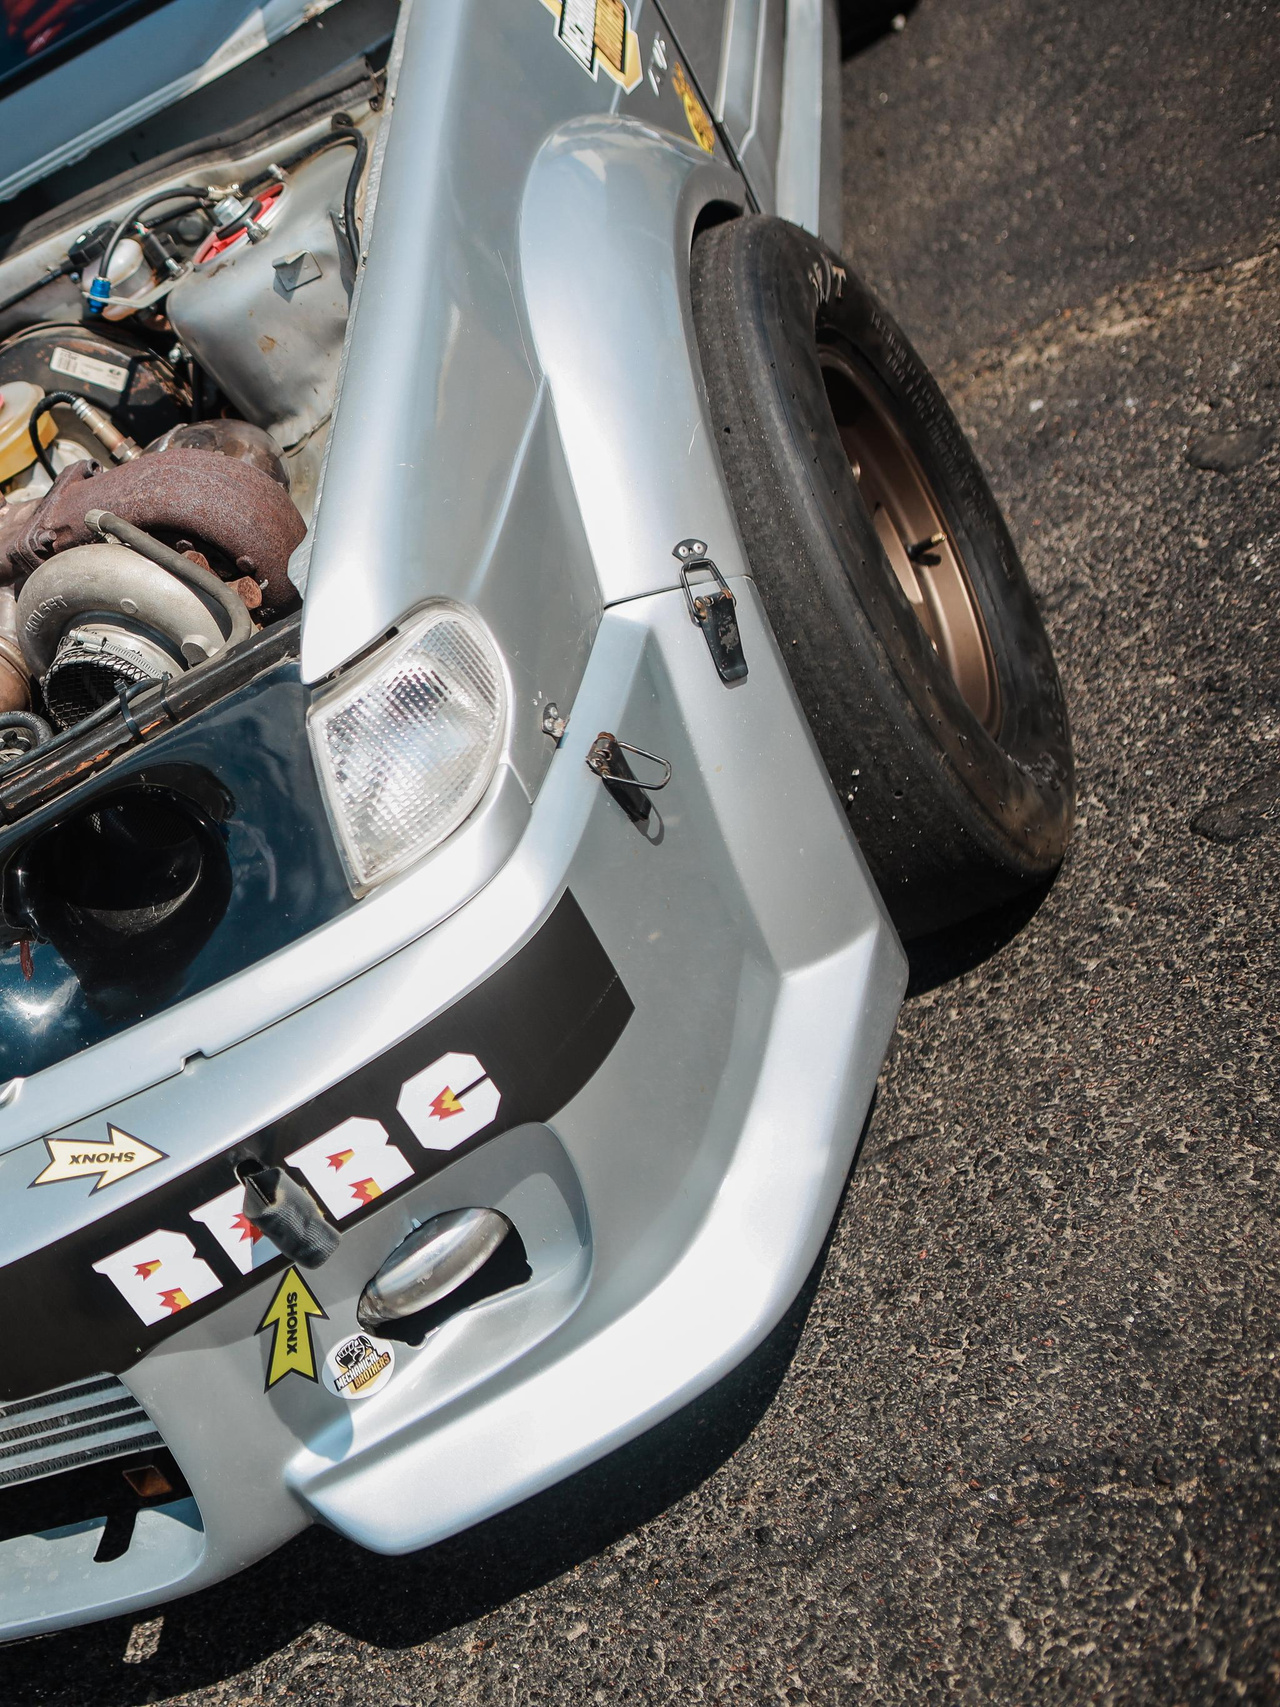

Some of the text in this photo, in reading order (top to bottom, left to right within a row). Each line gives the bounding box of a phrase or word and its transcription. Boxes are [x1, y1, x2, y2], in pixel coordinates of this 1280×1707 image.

[286, 1291, 298, 1356] SHONX
[334, 1349, 381, 1391] MECHANICAL
[353, 1351, 391, 1390] BROTHERS
